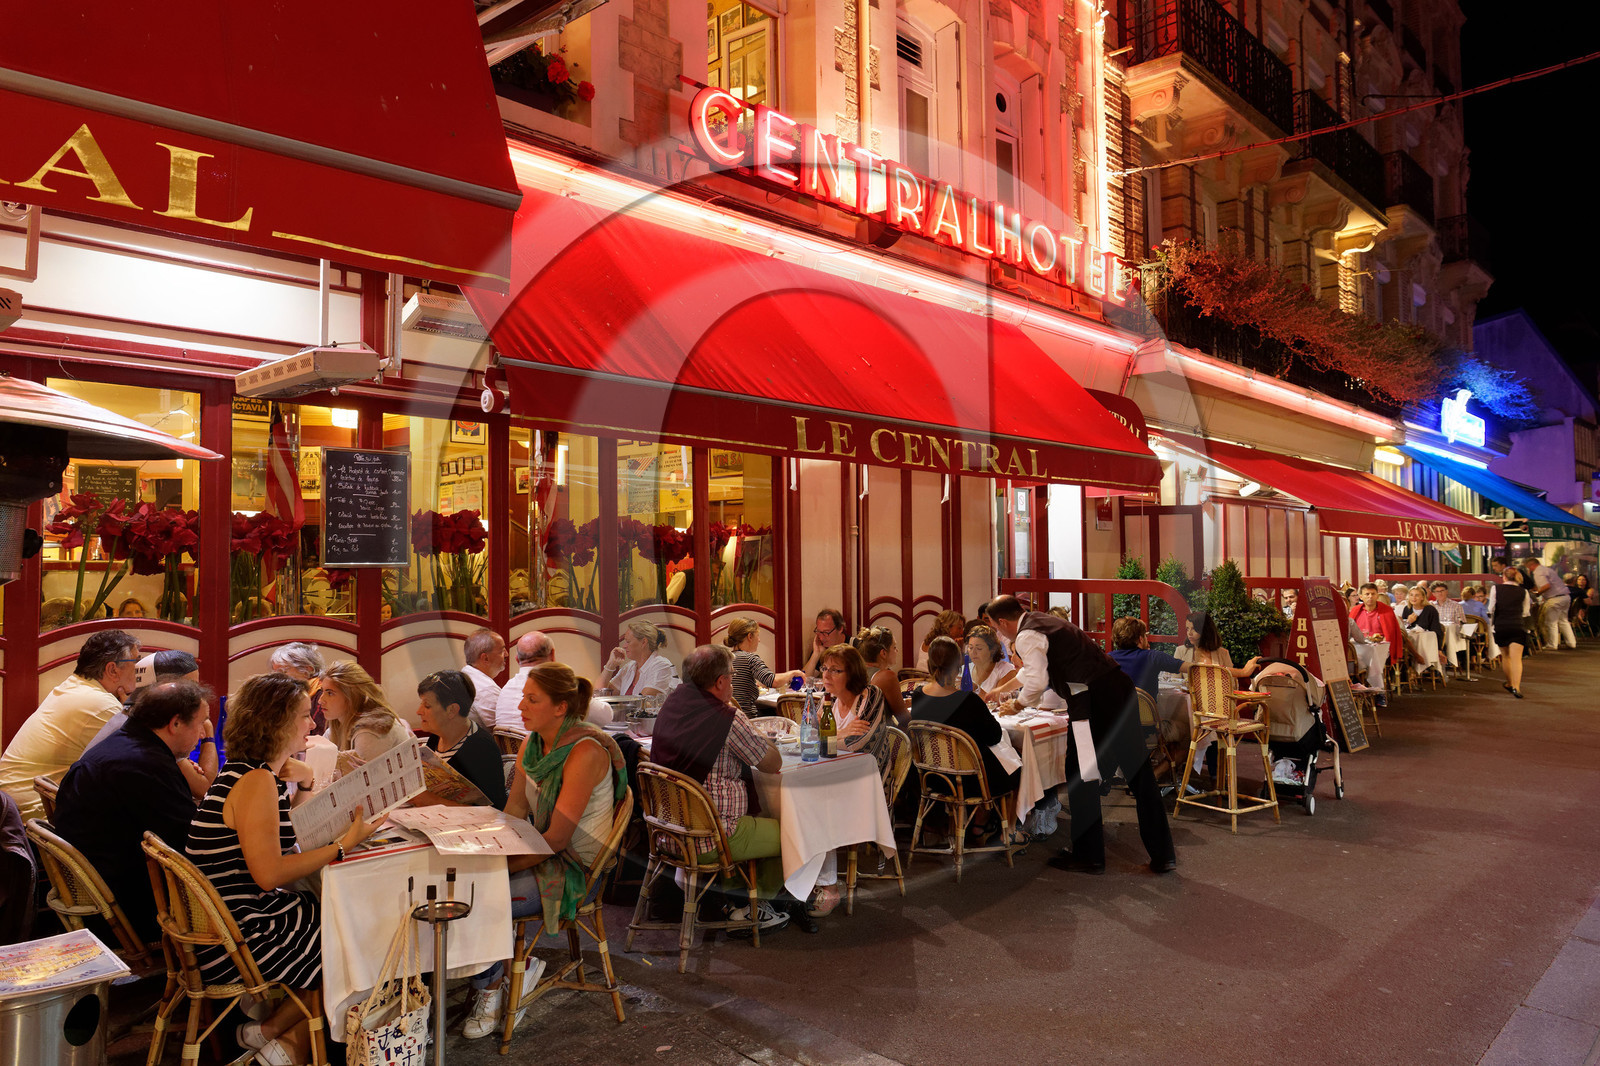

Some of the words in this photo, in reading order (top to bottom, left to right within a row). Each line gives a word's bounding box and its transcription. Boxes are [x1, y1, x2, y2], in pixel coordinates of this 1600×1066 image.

[0, 123, 254, 232] AL
[689, 86, 994, 256] CENTRAL
[996, 201, 1129, 303] HOTEL
[713, 454, 728, 467] VIN
[791, 415, 857, 458] LE
[869, 427, 1049, 479] CENTRAL
[1397, 520, 1413, 538] LE
